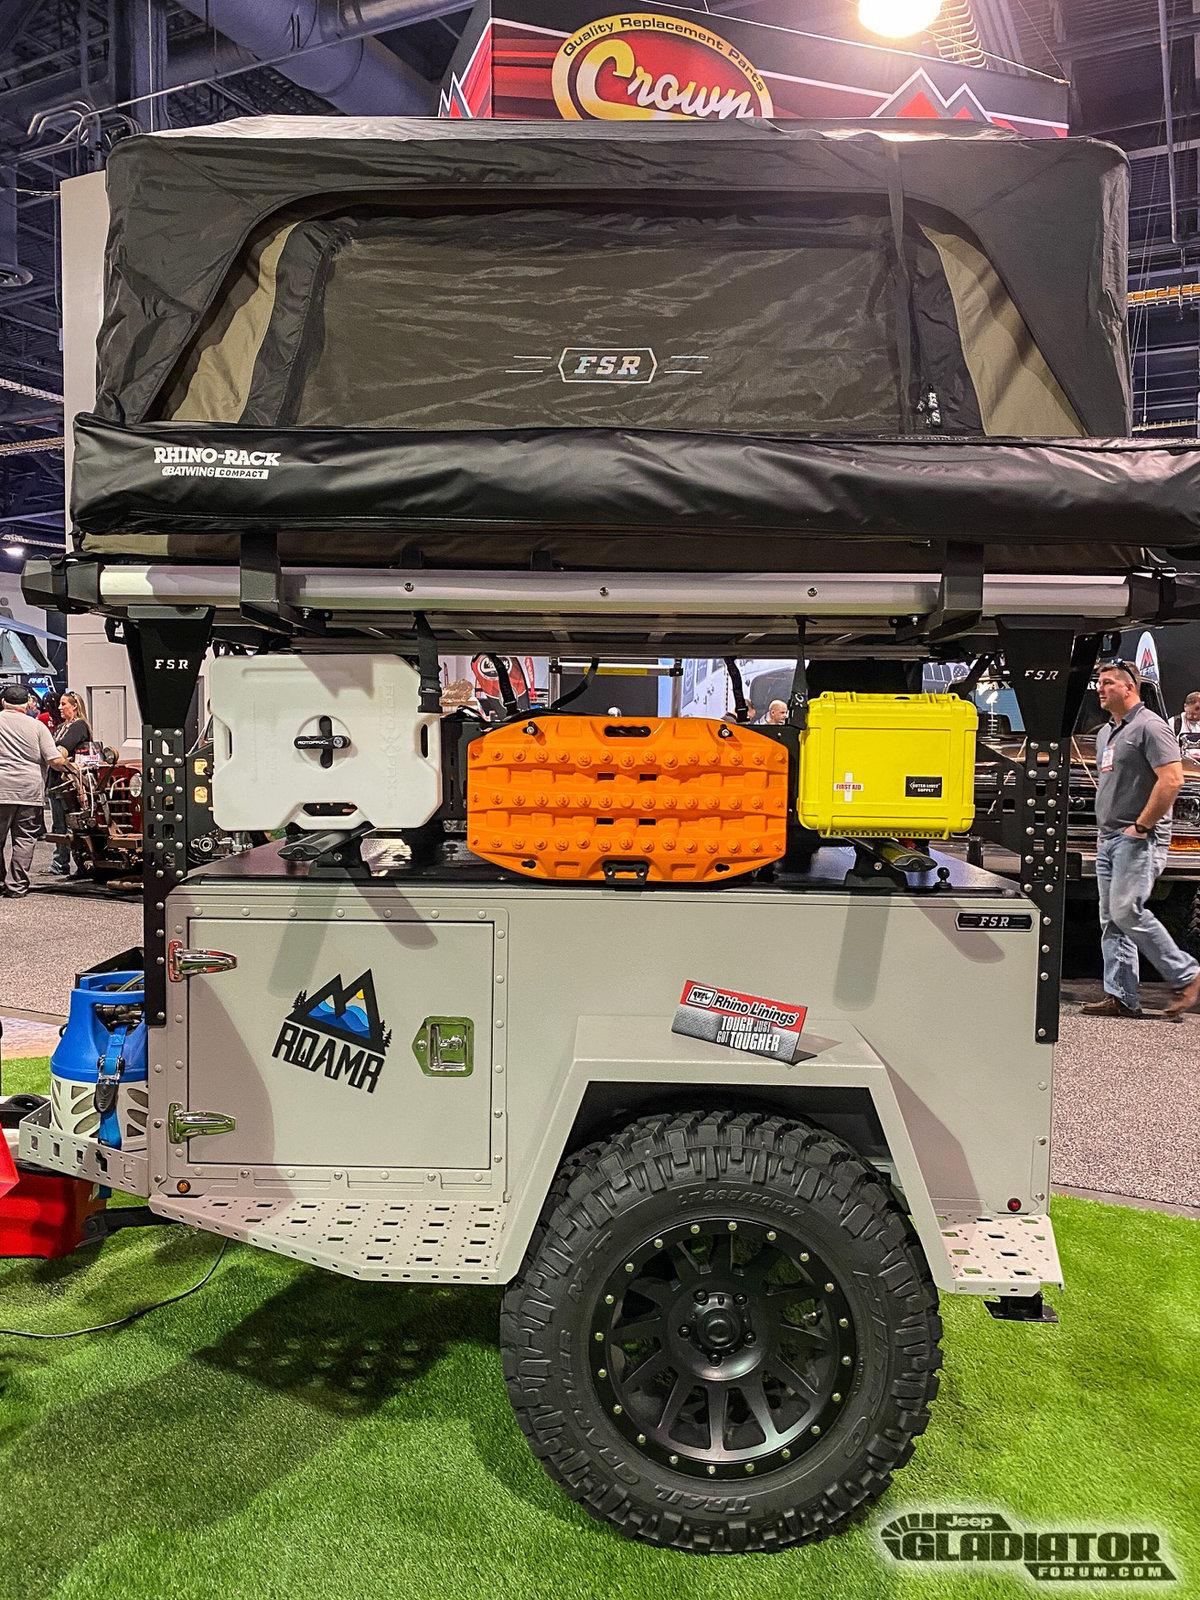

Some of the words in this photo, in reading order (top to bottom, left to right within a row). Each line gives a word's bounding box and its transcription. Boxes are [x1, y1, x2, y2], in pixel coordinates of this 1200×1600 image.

[563, 21, 614, 56] Quality
[620, 17, 723, 51] Replacement
[728, 48, 765, 92] Parts
[576, 39, 754, 119] Crown
[574, 356, 641, 375] FSR
[154, 447, 281, 466] RHINO-RACK
[163, 466, 215, 477] BATWING
[219, 469, 264, 478] COMPACT
[154, 659, 189, 670] FSR
[979, 916, 1010, 927] FSR
[714, 995, 749, 1014] Rhino
[750, 1002, 799, 1024] Linings
[721, 1016, 753, 1031] TOUGH
[754, 1020, 771, 1033] JUST
[716, 1031, 730, 1043] GOT
[730, 1031, 780, 1052] TOUGHER
[272, 1021, 385, 1093] ROAMR
